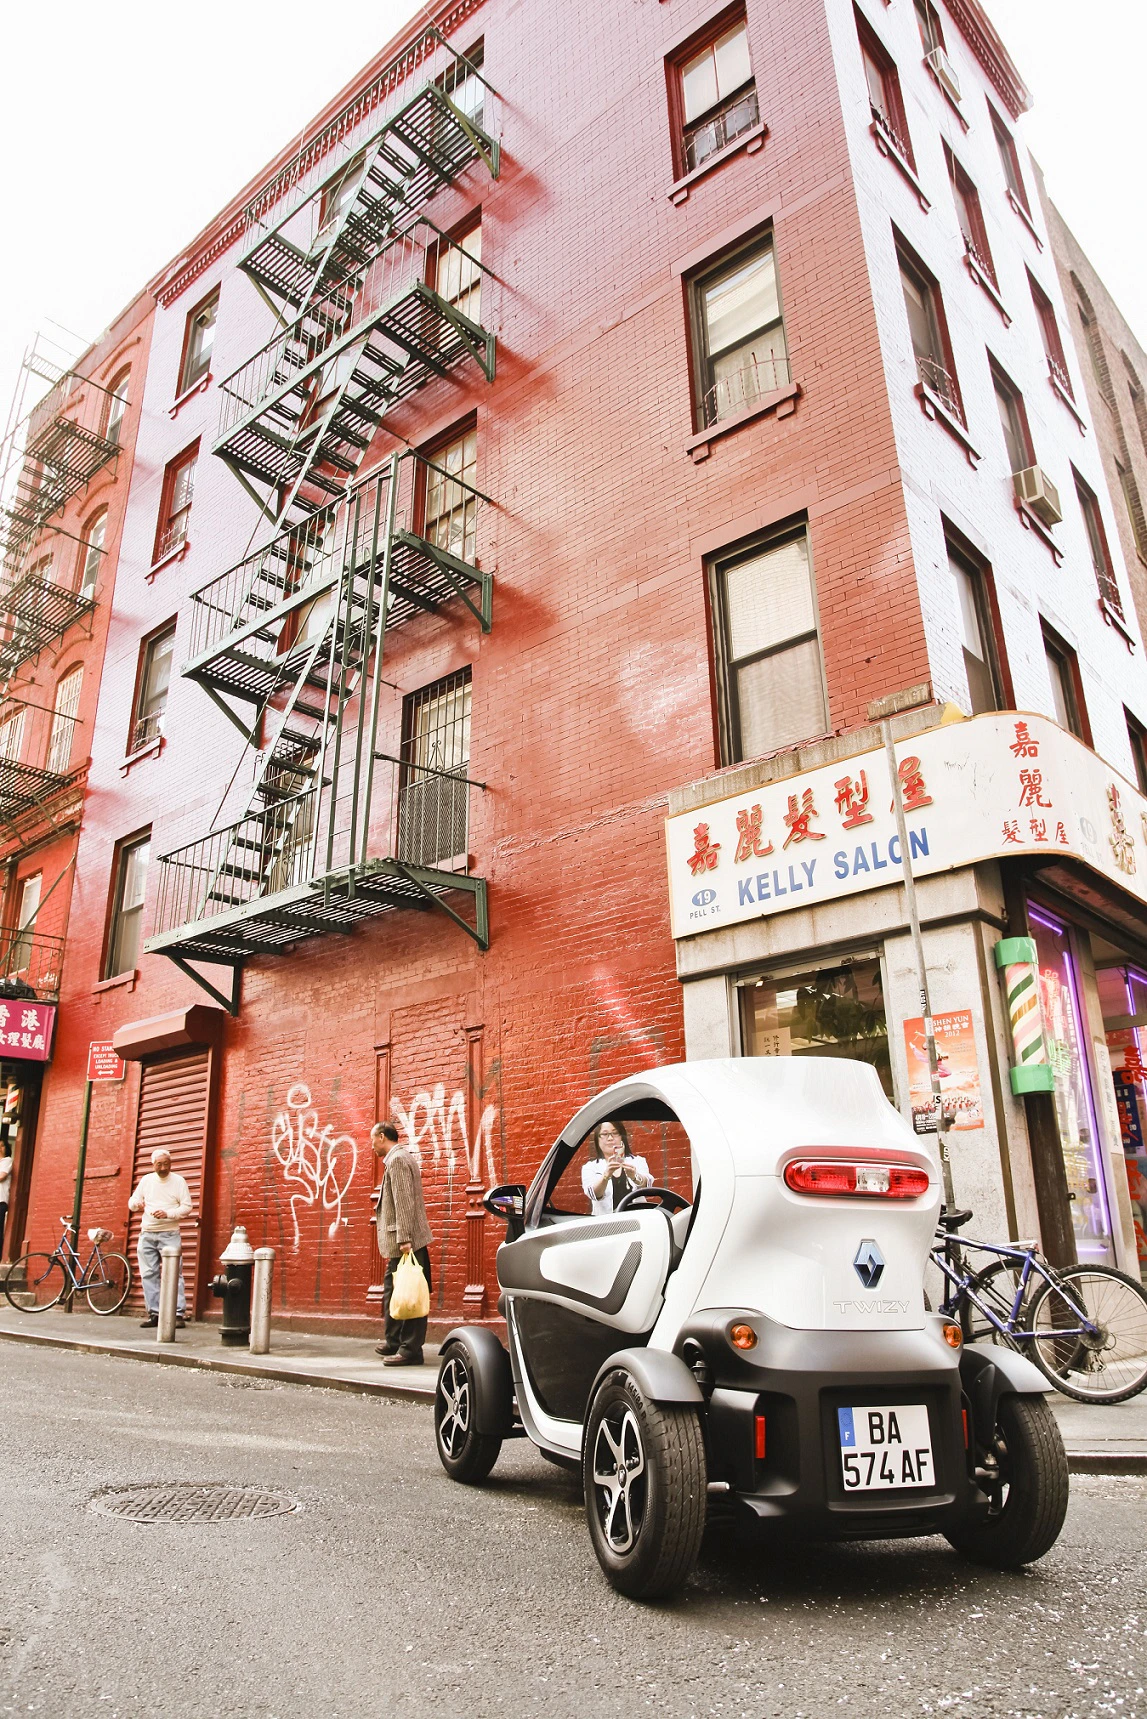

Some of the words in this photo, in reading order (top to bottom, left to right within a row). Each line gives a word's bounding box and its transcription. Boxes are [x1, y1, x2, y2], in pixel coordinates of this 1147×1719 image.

[1009, 720, 1053, 808] 嘉麗
[686, 755, 933, 877] 嘉麗髮型屋
[1001, 819, 1070, 846] 髮型屋
[737, 858, 820, 907] KELLY
[696, 890, 711, 905] 19
[689, 909, 707, 919] PELL
[711, 905, 721, 914] ST.
[932, 1017, 953, 1027] SHEN
[953, 1015, 969, 1024] YUN
[944, 1030, 960, 1038] 2012
[833, 1300, 910, 1314] TWIZY
[844, 1431, 851, 1441] F
[868, 1411, 902, 1445] BA
[843, 1450, 895, 1488] 574
[901, 1448, 930, 1483] AF
